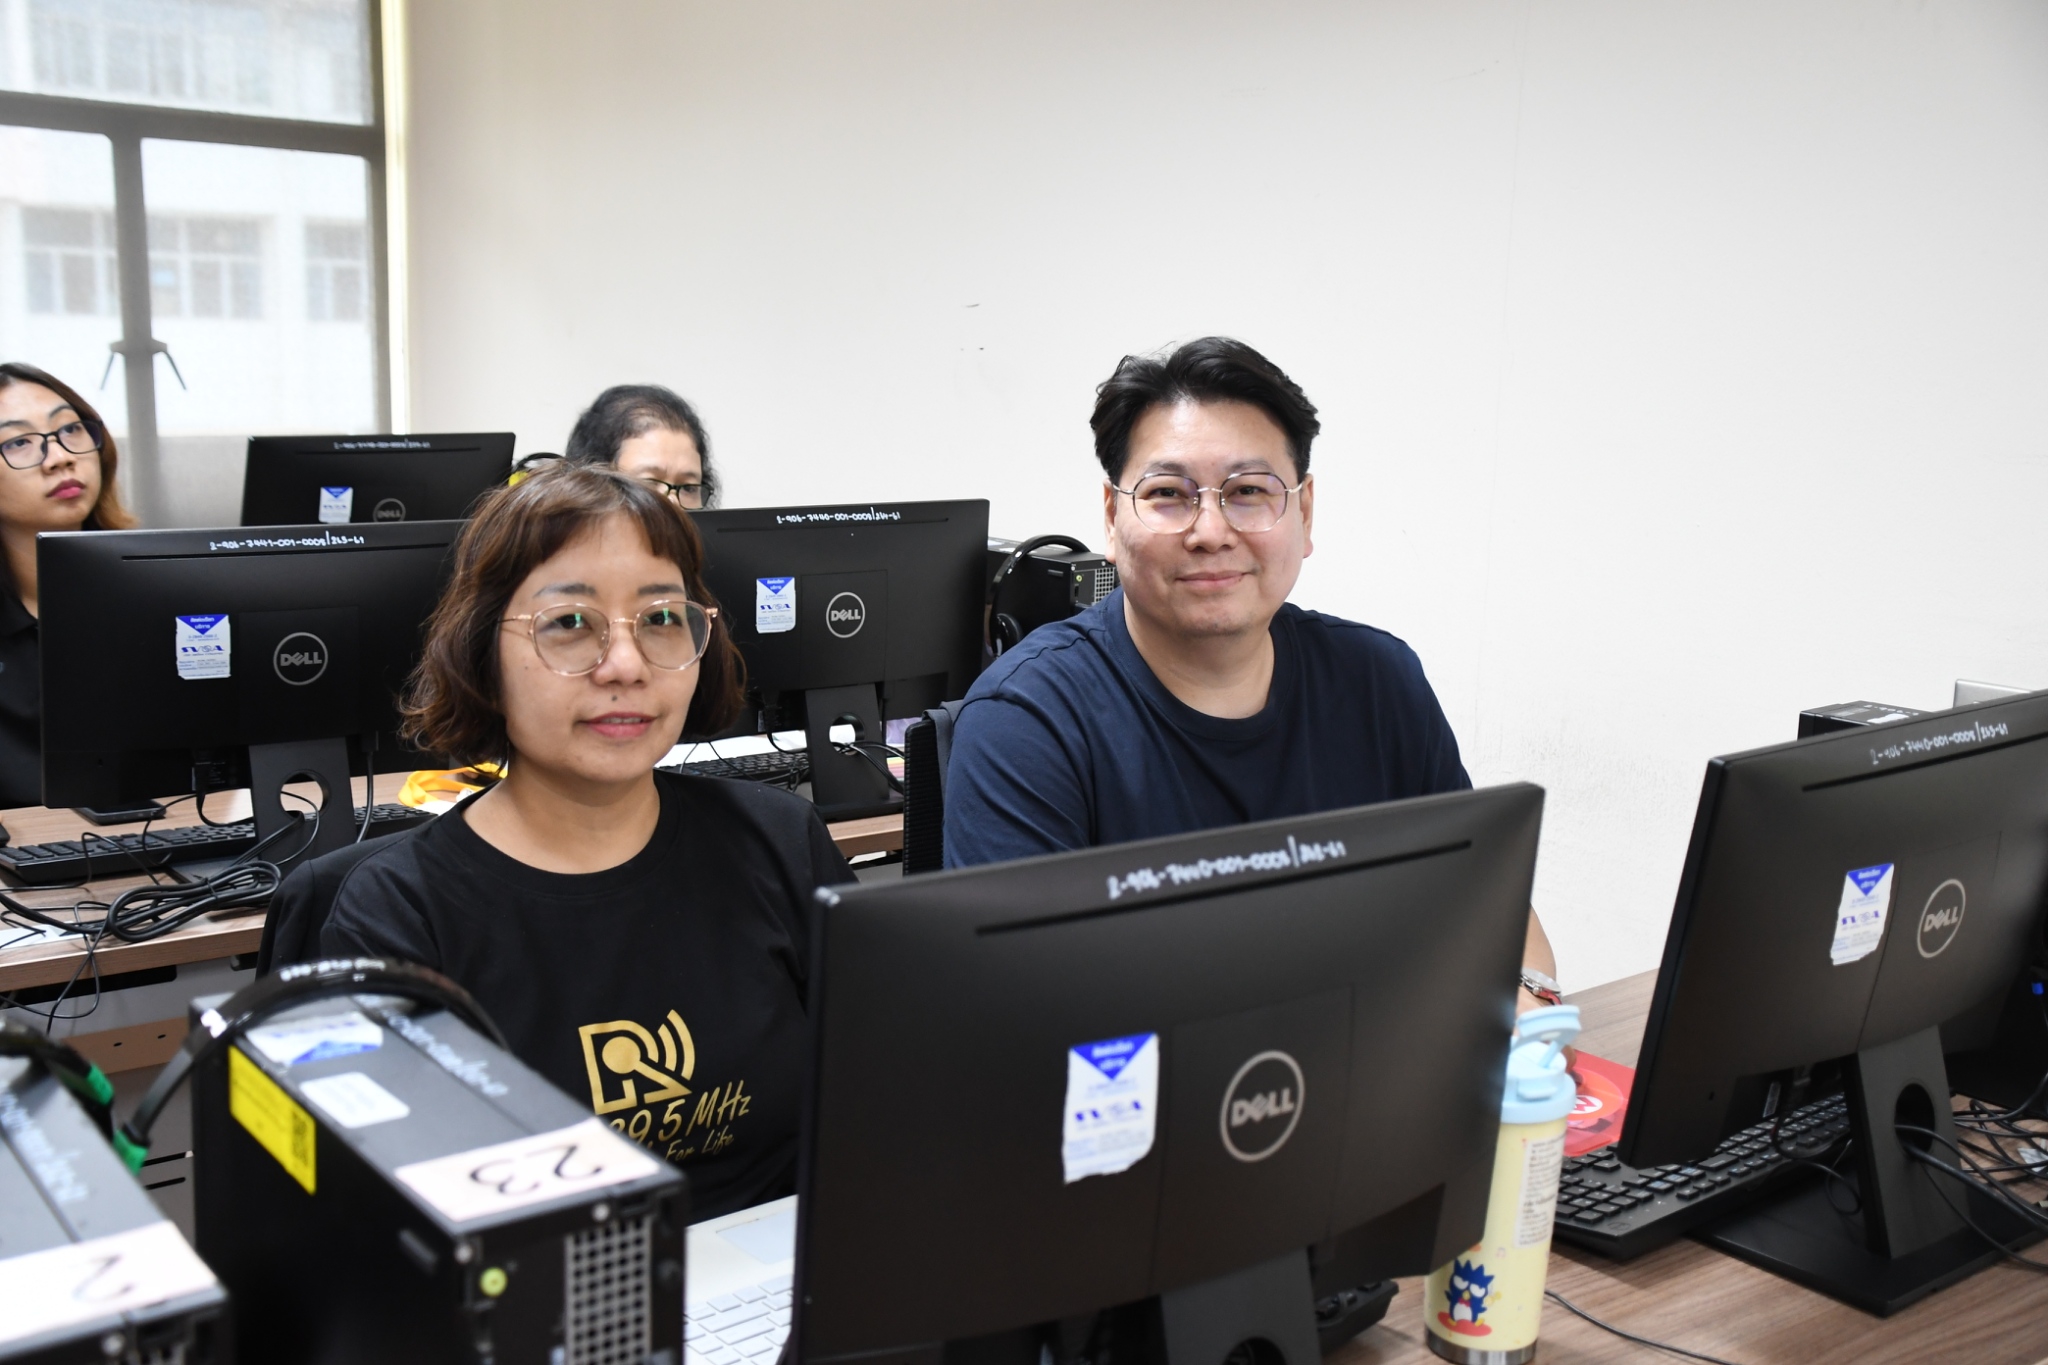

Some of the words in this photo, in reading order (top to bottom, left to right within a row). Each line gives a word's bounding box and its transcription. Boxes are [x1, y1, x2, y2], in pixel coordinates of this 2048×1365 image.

[830, 609, 861, 622] DELL
[279, 652, 322, 667] DELL
[1923, 906, 1958, 932] DELL
[686, 1079, 752, 1138] MHz
[1230, 1087, 1295, 1128] DELL
[664, 1139, 695, 1162] For
[701, 1125, 735, 1156] Life
[468, 1143, 605, 1197] 23
